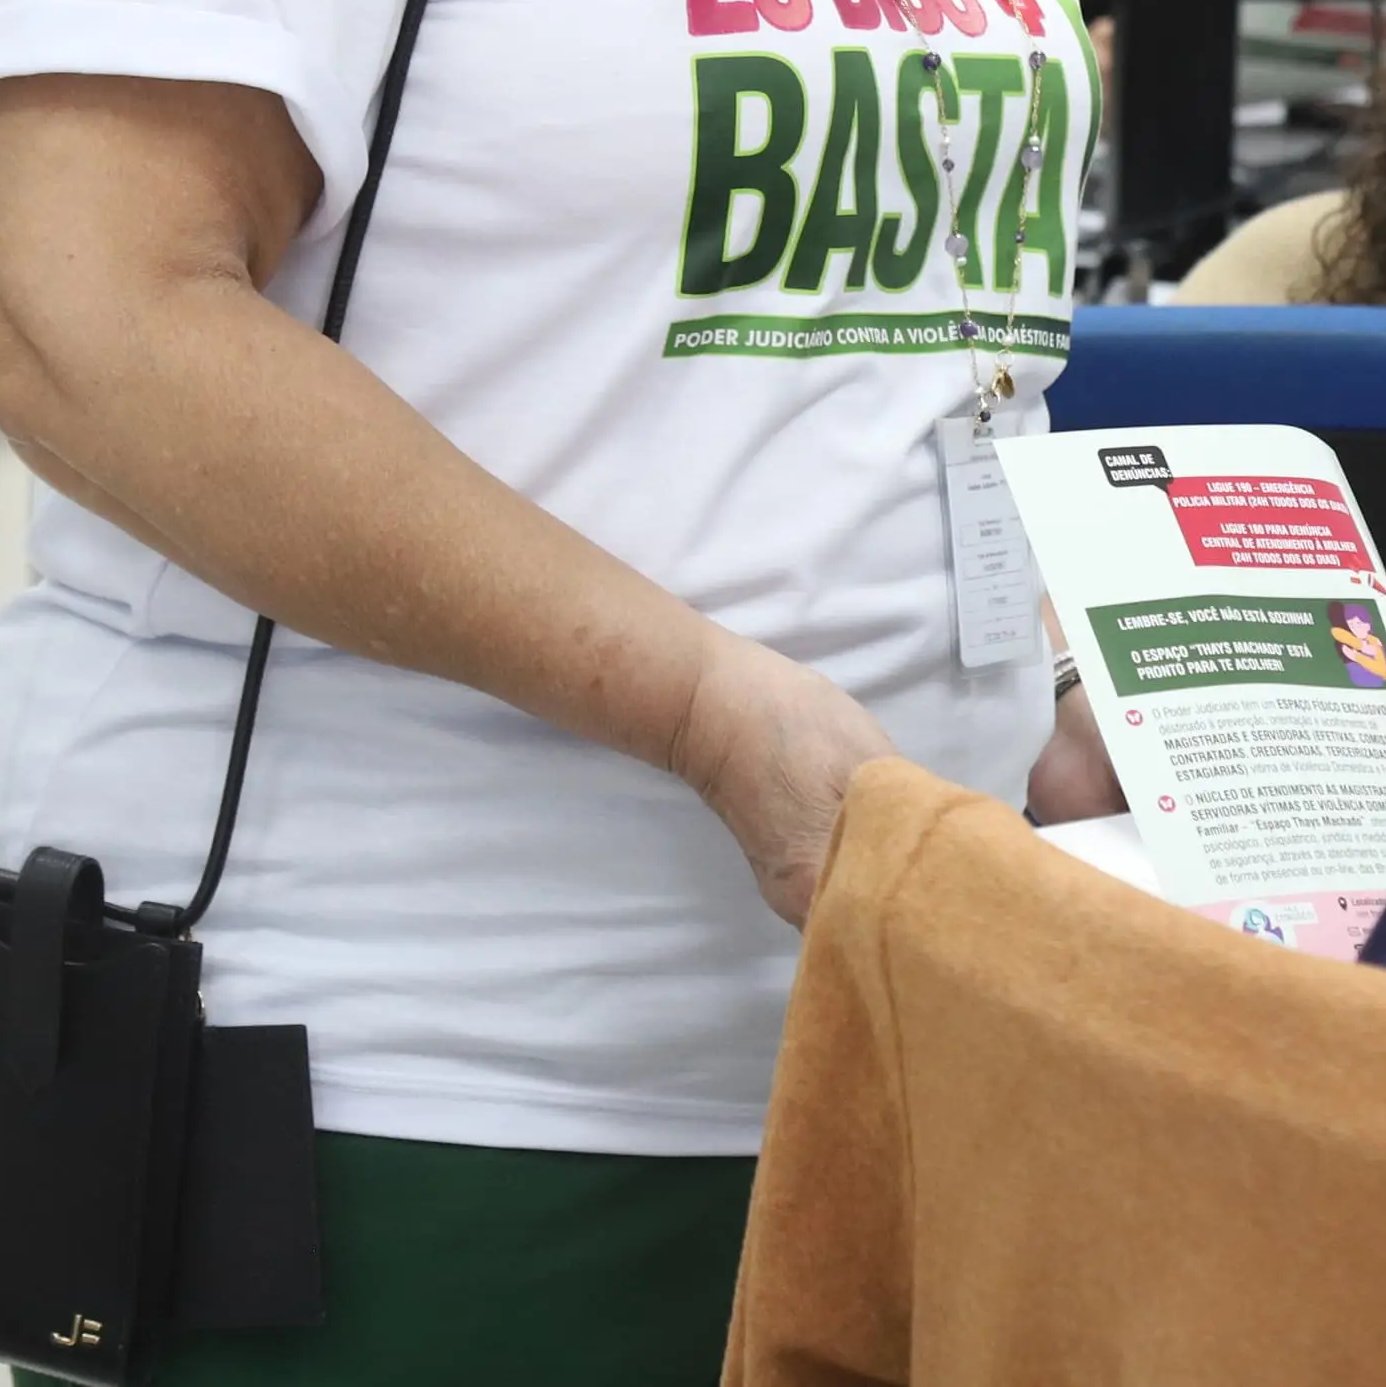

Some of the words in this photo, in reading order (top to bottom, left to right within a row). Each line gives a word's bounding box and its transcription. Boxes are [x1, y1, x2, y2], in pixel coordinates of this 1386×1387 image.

[674, 329, 738, 349] PODER
[744, 326, 832, 349] JUDICIÁRIO
[837, 327, 889, 346] CONTRA
[892, 328, 905, 344] A
[1105, 453, 1139, 467] CANAL
[1139, 453, 1155, 465] DE
[1111, 465, 1172, 481] DENÚNCIAS:
[1207, 482, 1234, 493] LIGUE
[1235, 483, 1252, 494] 190
[1260, 480, 1315, 495] EMERGÊNCIA
[1211, 495, 1248, 506] MILITAR
[1249, 496, 1268, 508] (24H
[1269, 497, 1298, 508] TODOS
[1299, 498, 1317, 509] DOS
[1317, 499, 1330, 510] OS
[1221, 523, 1247, 534] LIGUE
[1265, 524, 1288, 535] PARA
[1288, 522, 1333, 536] DENÚNCIA
[1202, 537, 1241, 548] CENTRAL
[1242, 538, 1255, 548] DE
[1255, 538, 1314, 550] ATENDIMENTO
[1322, 540, 1358, 553] MULHER
[1232, 552, 1251, 564] (24H
[1253, 553, 1282, 564] TODOS
[1283, 554, 1301, 565] DOS
[1302, 554, 1315, 565] OS
[1315, 554, 1341, 566] DIAS)
[1117, 611, 1189, 631] LEMBRE-SE,
[1187, 606, 1220, 623] VOCÊ
[1219, 605, 1243, 621] NÃO
[1243, 607, 1268, 623] ESTÁ
[1269, 612, 1315, 626] SOZINHA!
[1131, 650, 1142, 664] O
[1142, 645, 1189, 662] ESPAÇO
[1286, 643, 1313, 658] ESTÁ
[1137, 662, 1186, 681] PRONTO
[1186, 659, 1218, 675] PARA
[1218, 658, 1234, 672] TE
[1235, 658, 1285, 672] ACOLHER!
[1152, 707, 1162, 719] O
[1163, 705, 1192, 718] Poder
[1241, 700, 1260, 711] tem
[1276, 698, 1312, 712] ESPAÇO
[1163, 731, 1241, 751] MAGISTRADAS
[1242, 730, 1250, 742] E
[1251, 728, 1311, 742] SERVIDORAS
[1184, 794, 1194, 806] O
[1239, 787, 1256, 799] DE
[1256, 784, 1324, 798] ATENDIMENTO
[1190, 803, 1258, 821] SERVIDORAS
[1302, 800, 1317, 811] DE
[1317, 797, 1366, 812] VIOLÊNCIA
[1196, 823, 1239, 837] Familiar
[1292, 816, 1321, 829] Thays
